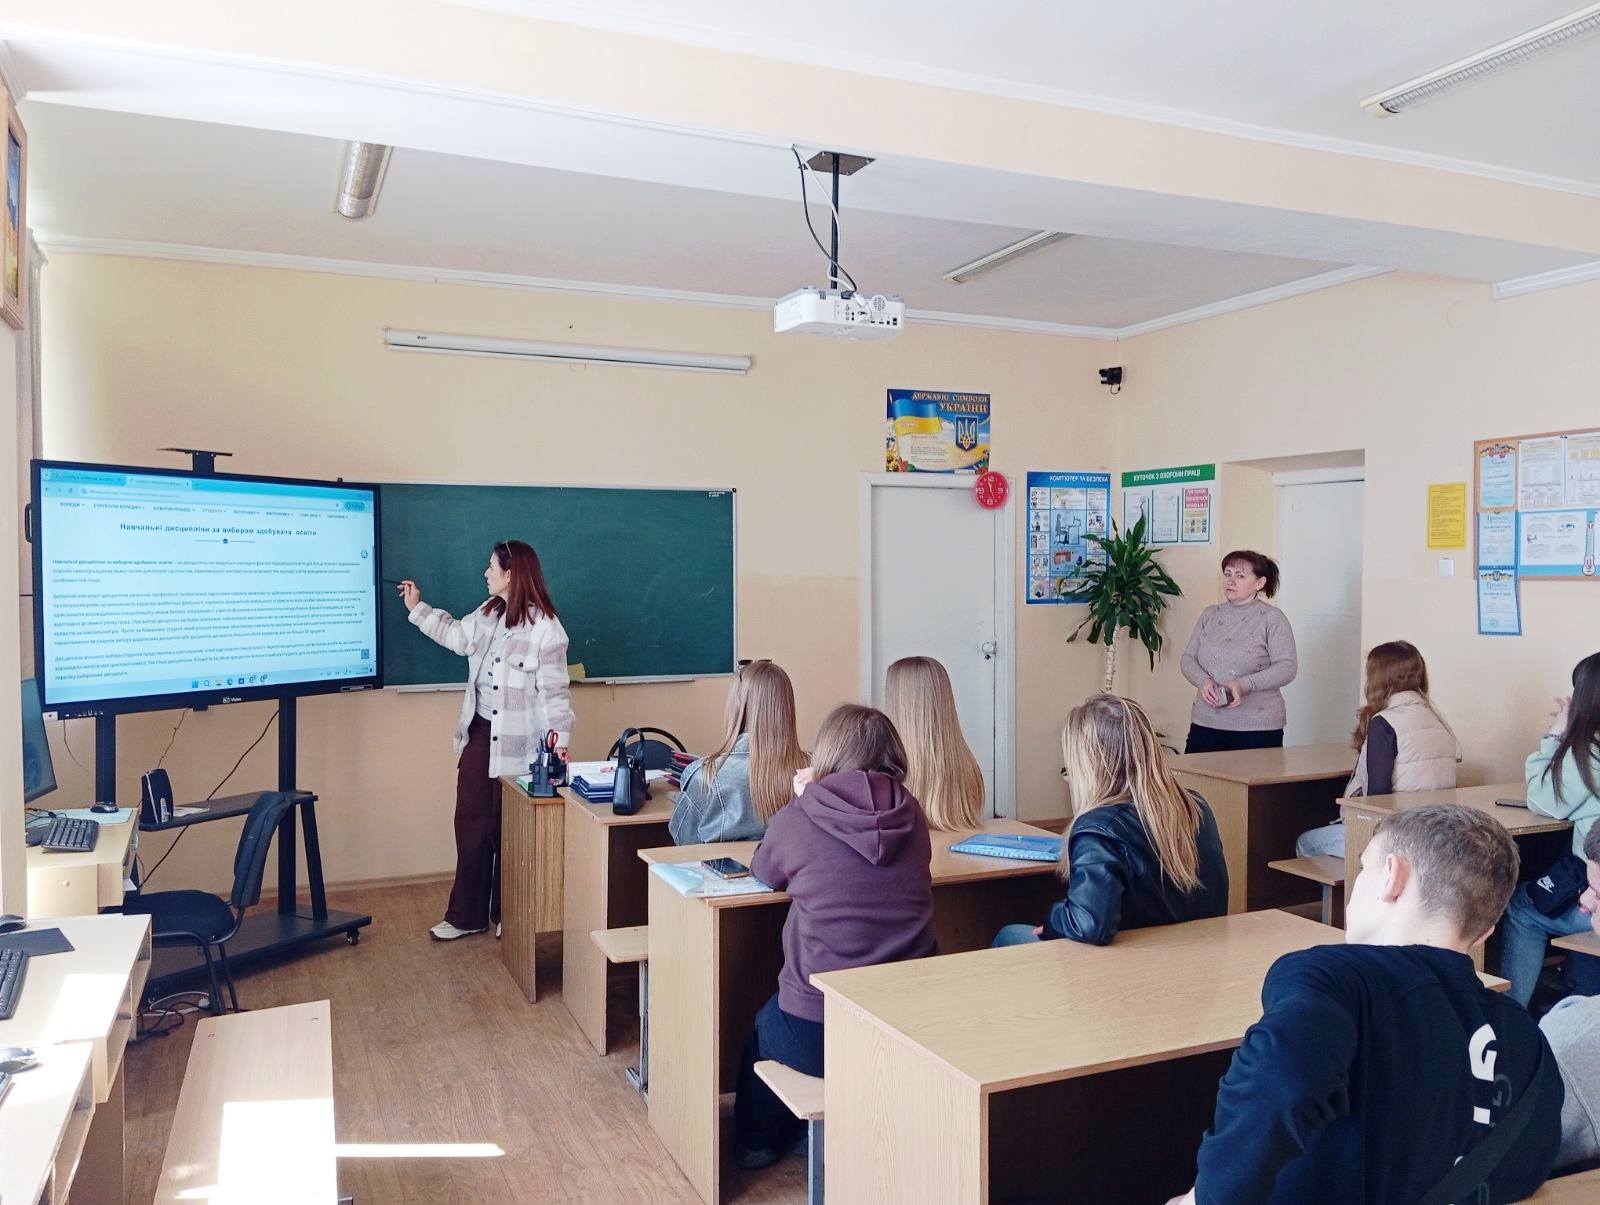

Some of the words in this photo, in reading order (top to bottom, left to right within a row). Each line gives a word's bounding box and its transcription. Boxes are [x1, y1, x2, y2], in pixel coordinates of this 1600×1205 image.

[912, 392, 949, 401] ДЕРЖАВНІ
[952, 394, 988, 402] СИМВОЛИ
[940, 402, 987, 413] УКРАЇНИ
[1086, 475, 1108, 483] БЕЗПЕКА
[1134, 473, 1155, 482] КУТОЧОК
[1160, 470, 1184, 479] ОХОРОНИ
[1184, 469, 1200, 477] ПРАЦІ
[120, 523, 162, 531] Навчальні
[165, 525, 210, 534] дисципліни
[223, 526, 254, 535] вибором
[256, 528, 292, 536] здобувача
